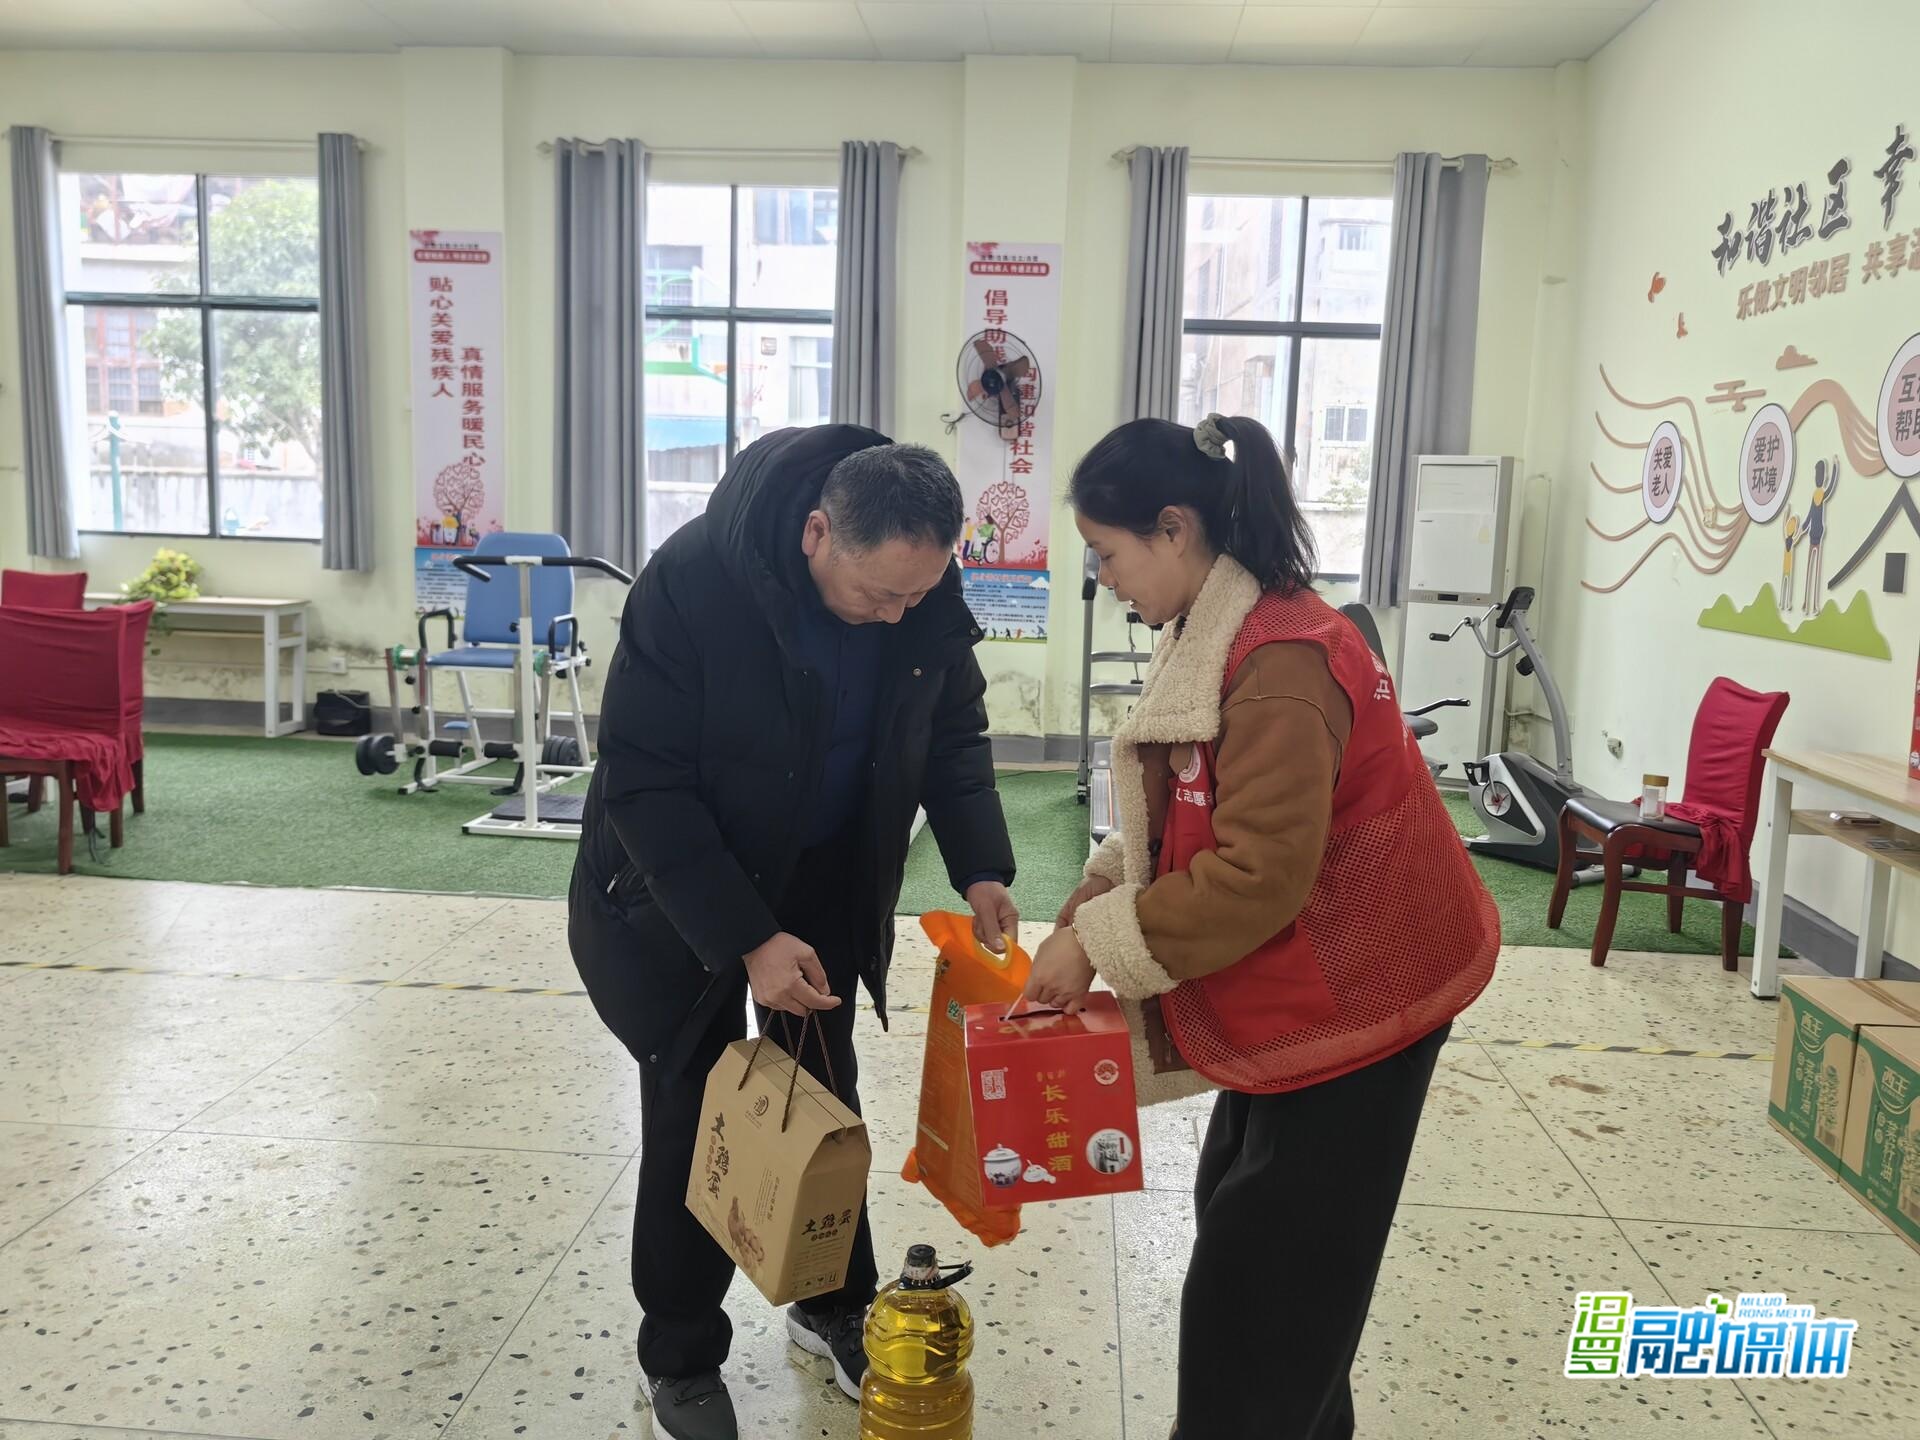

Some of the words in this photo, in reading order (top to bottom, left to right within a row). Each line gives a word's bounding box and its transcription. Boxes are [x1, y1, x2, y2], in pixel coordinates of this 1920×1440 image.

[1712, 158, 1850, 277] 和谐社区
[429, 276, 454, 398] 贴心关爱残疾人
[1897, 372, 1920, 403] 互
[461, 347, 485, 467] 真情服务暖民心
[1653, 446, 1673, 471] 关爱
[1753, 435, 1780, 464] 爱护
[1651, 475, 1671, 497] 老人
[1751, 466, 1778, 494] 环境
[1882, 1065, 1911, 1098] 西王
[1042, 1084, 1073, 1172] 长乐甜酒
